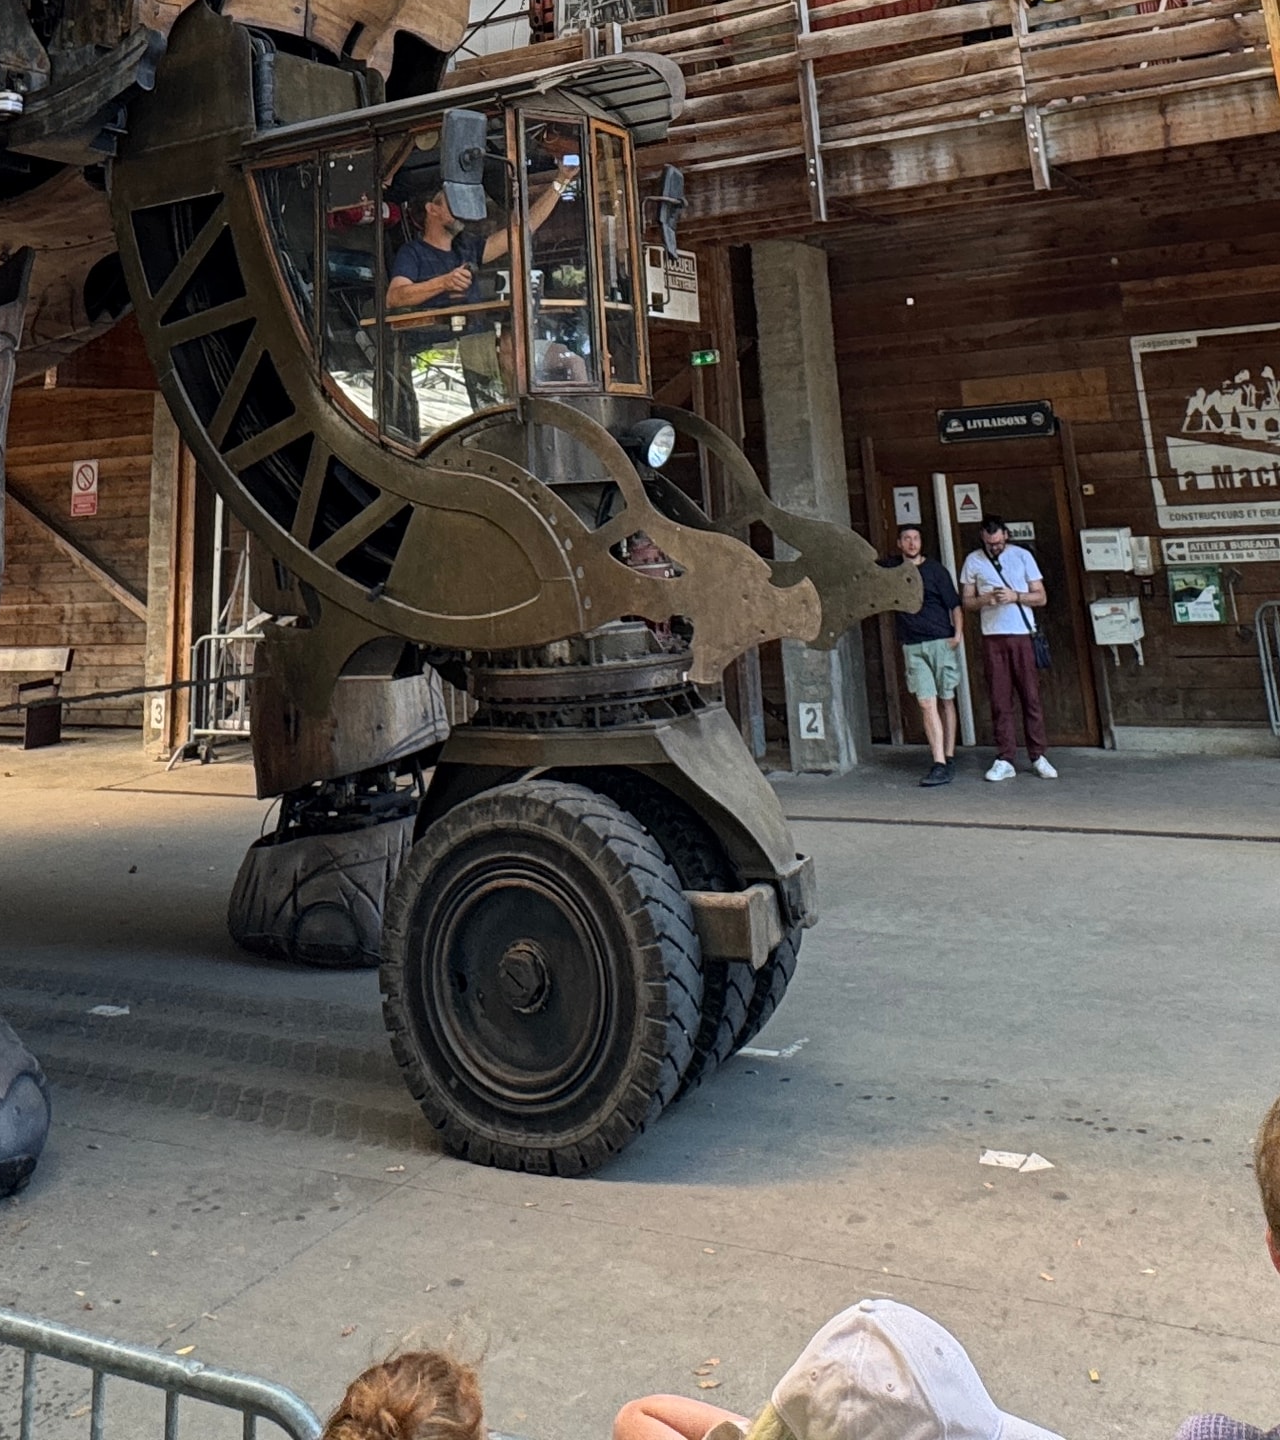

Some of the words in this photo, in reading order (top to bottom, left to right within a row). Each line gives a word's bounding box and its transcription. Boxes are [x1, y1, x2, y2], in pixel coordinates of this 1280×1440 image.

[966, 415, 1027, 430] LIVRAISONS
[903, 501, 911, 513] 1
[1169, 509, 1246, 522] CONSTRUCTEURS
[1247, 511, 1258, 519] ET
[1189, 540, 1227, 553] ATELIER
[1230, 537, 1277, 550] BUREAUX
[154, 703, 163, 725] 3
[805, 707, 819, 733] 2
